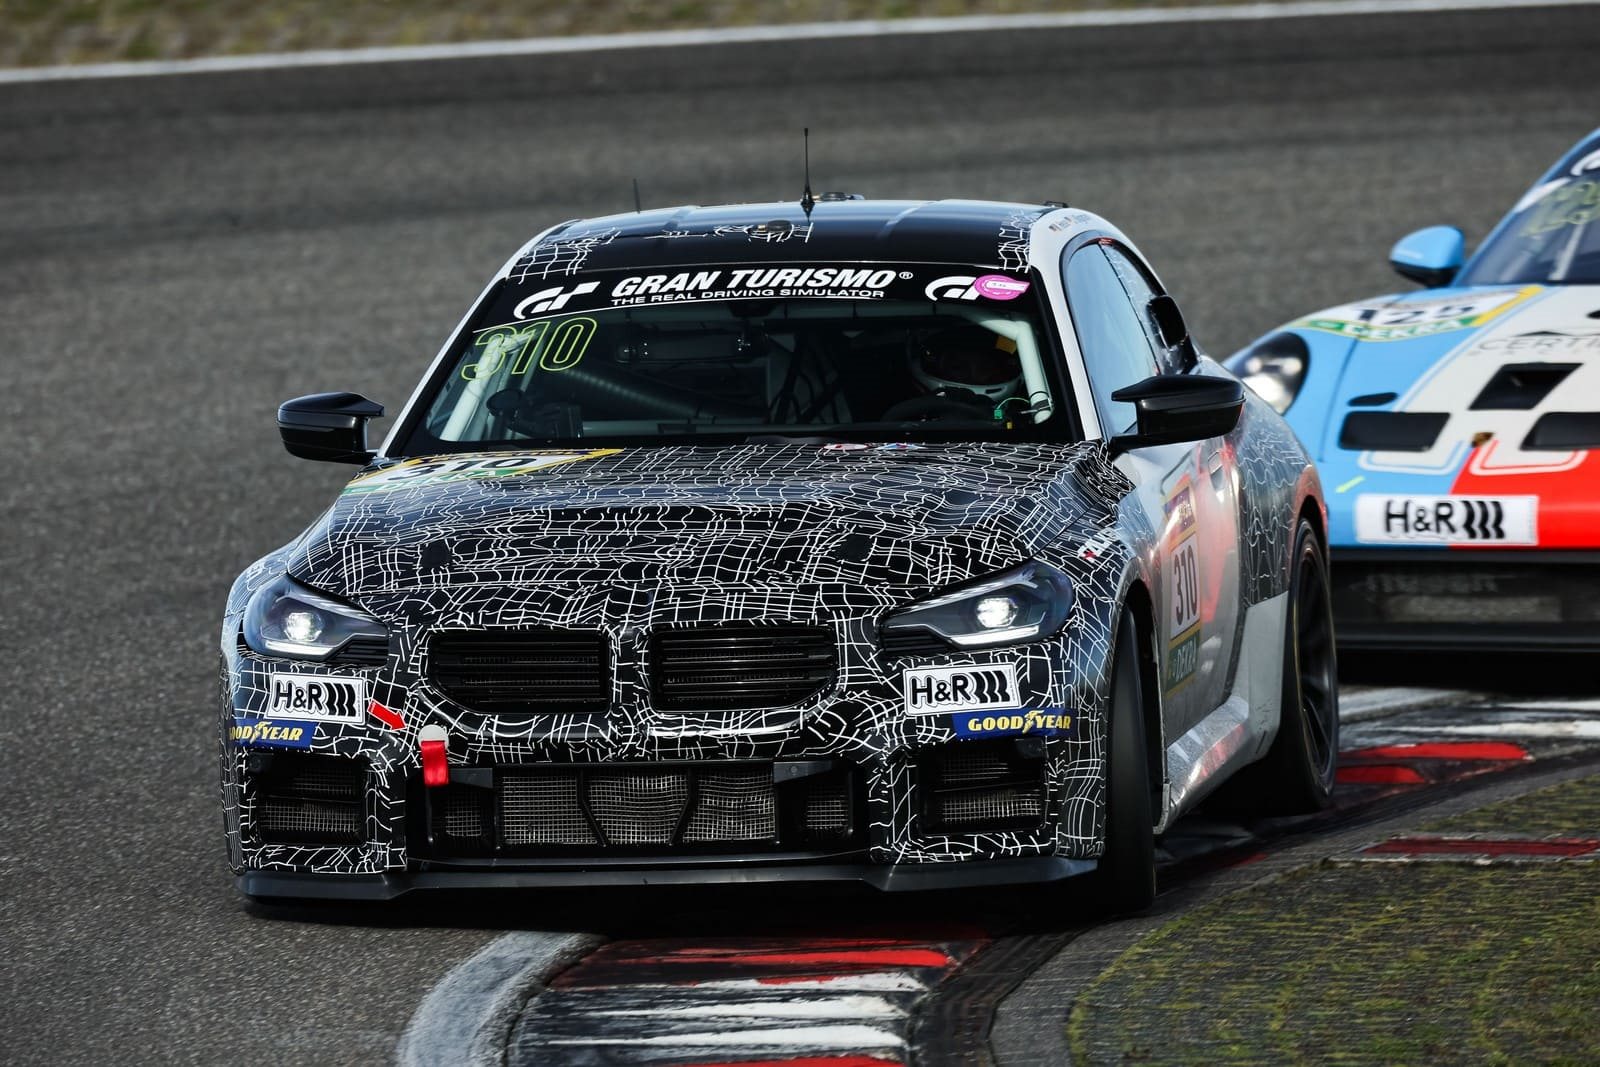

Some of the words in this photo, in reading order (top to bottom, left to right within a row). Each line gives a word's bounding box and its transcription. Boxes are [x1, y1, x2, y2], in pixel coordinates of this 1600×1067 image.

[611, 270, 722, 298] GRAN
[611, 296, 646, 306] THE
[651, 292, 697, 303] REAL
[701, 289, 774, 299] DRIVING
[779, 288, 885, 298] SIMULATOR
[461, 317, 598, 381] 310
[1479, 337, 1600, 350] CERTI
[387, 457, 537, 481] 310
[1385, 499, 1457, 534] H&R
[1173, 544, 1198, 627] 310
[273, 680, 324, 712] H&R
[910, 673, 973, 706] H&R
[967, 710, 1072, 733] GOODYEAR
